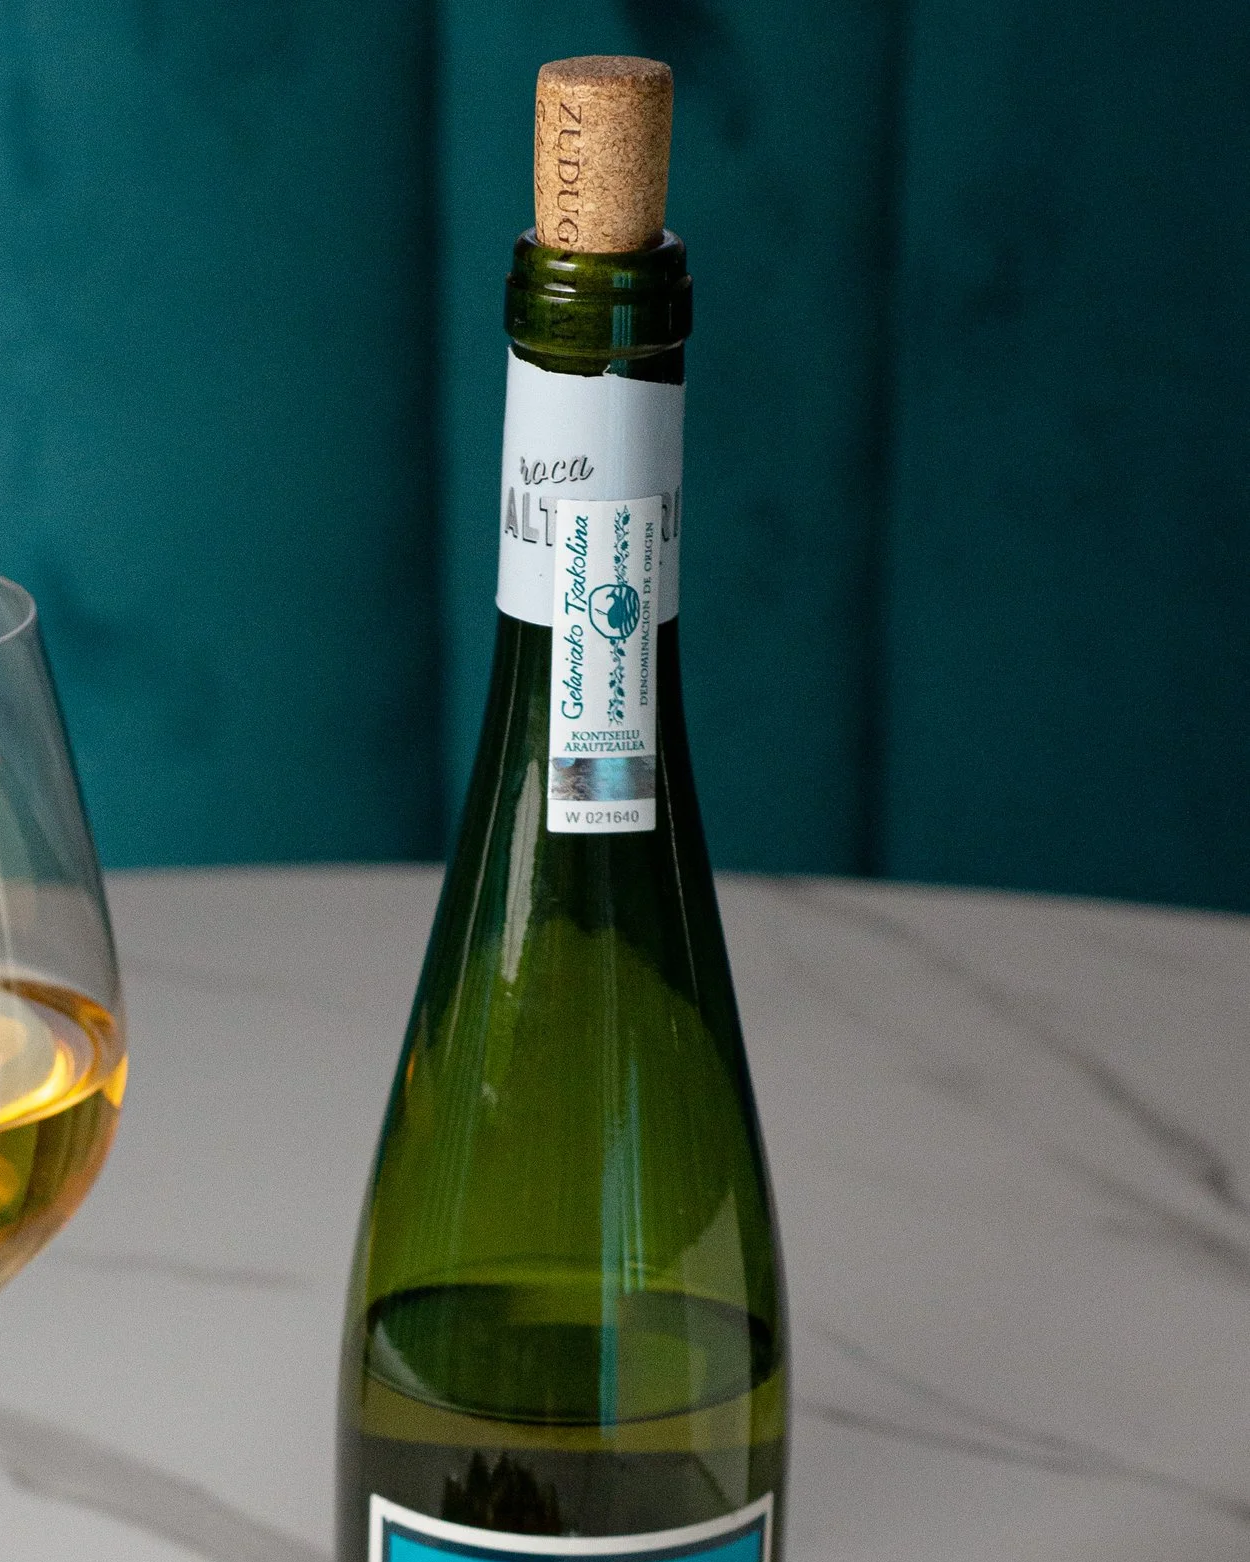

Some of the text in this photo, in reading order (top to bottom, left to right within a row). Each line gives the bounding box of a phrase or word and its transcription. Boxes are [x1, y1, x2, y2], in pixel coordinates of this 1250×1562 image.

[520, 455, 594, 485] roca
[643, 522, 654, 572] ORIGEN
[642, 577, 652, 594] DE
[561, 515, 589, 719] Getariako Txakolina
[571, 730, 640, 741] KONTSEILU
[564, 740, 646, 752] ARAUTZAILEA
[565, 810, 640, 824] W 021640
